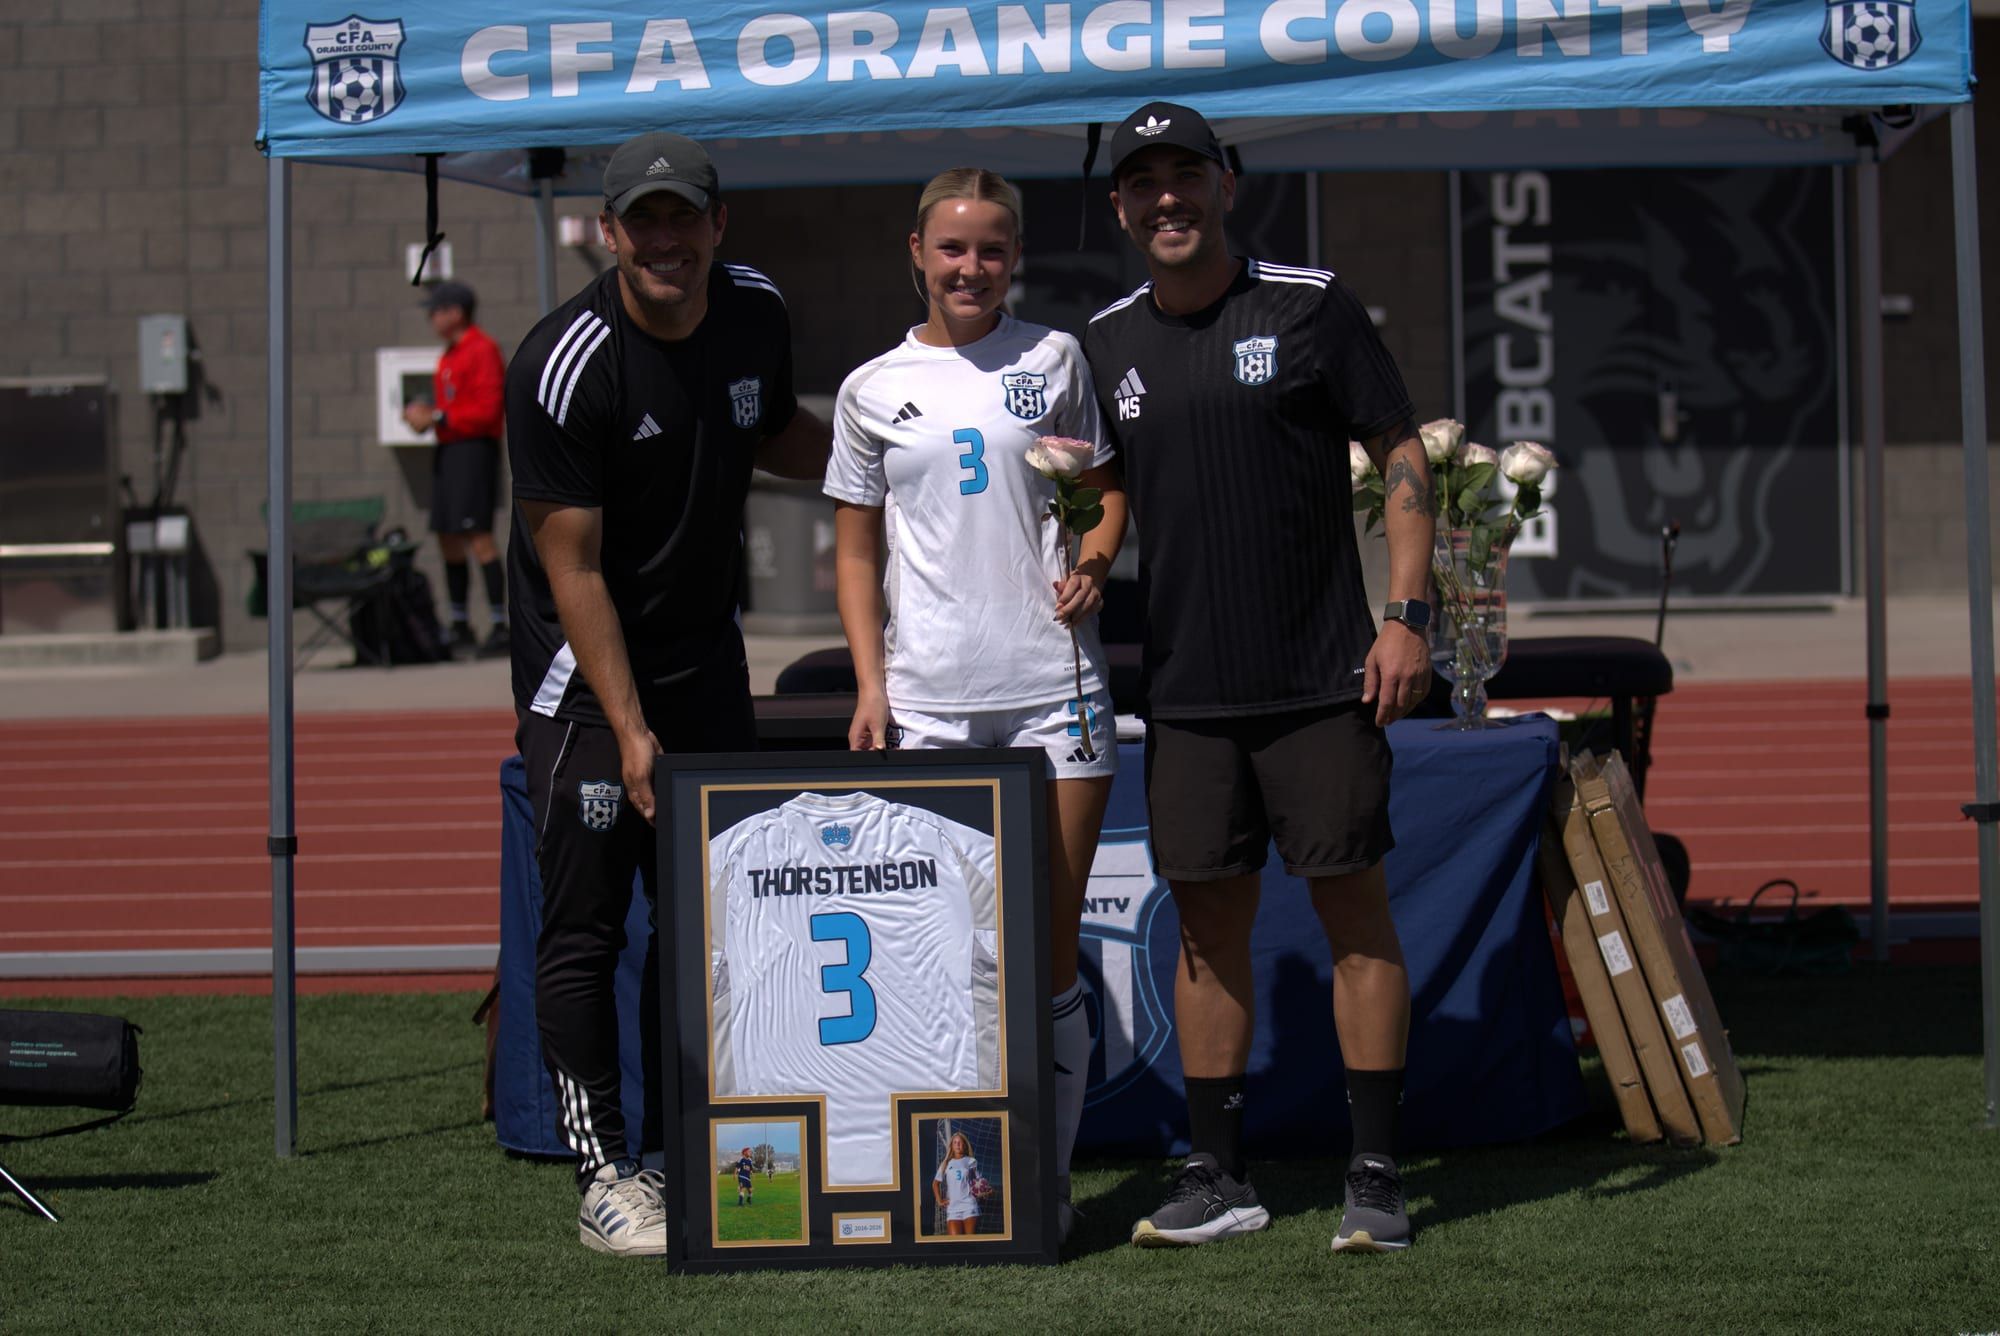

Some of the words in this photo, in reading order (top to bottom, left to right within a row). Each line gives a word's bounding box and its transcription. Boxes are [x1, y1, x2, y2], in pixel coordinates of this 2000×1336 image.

[316, 45, 353, 54] ORANGE
[355, 43, 393, 52] COUNTY
[336, 31, 374, 44] CFA
[459, 18, 711, 101] CFA
[736, 0, 1227, 86] ORANGE
[1259, 0, 1753, 65] COUNTY
[1118, 396, 1140, 421] MS
[952, 427, 989, 496] 3
[747, 859, 938, 898] THORSTENSON
[1082, 896, 1131, 914] NTY
[810, 911, 878, 1047] 3
